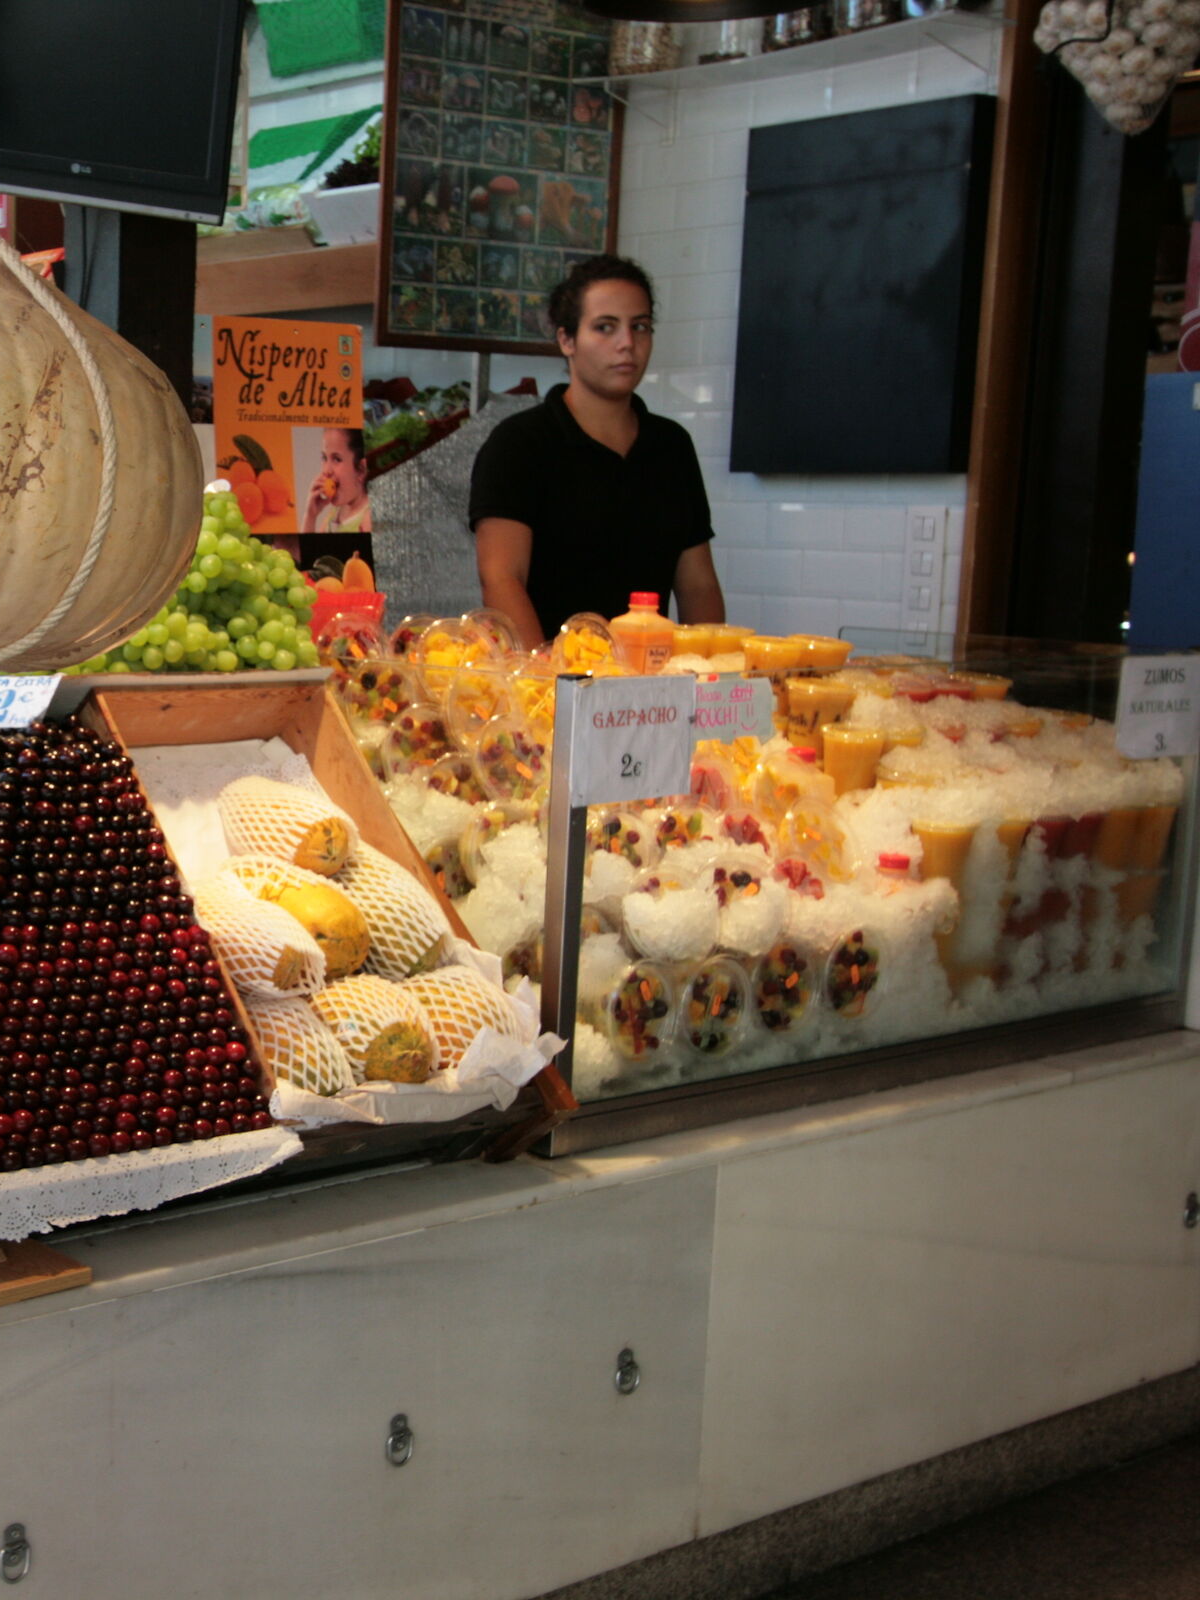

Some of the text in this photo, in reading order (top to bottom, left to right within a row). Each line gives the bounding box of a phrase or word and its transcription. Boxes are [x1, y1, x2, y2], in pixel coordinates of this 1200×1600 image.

[239, 368, 352, 408] de Altea
[1145, 669, 1185, 685] ZUMOS
[1131, 699, 1191, 714] NATURALES
[593, 707, 677, 729] GAZPACHO
[621, 754, 642, 778] 2€
